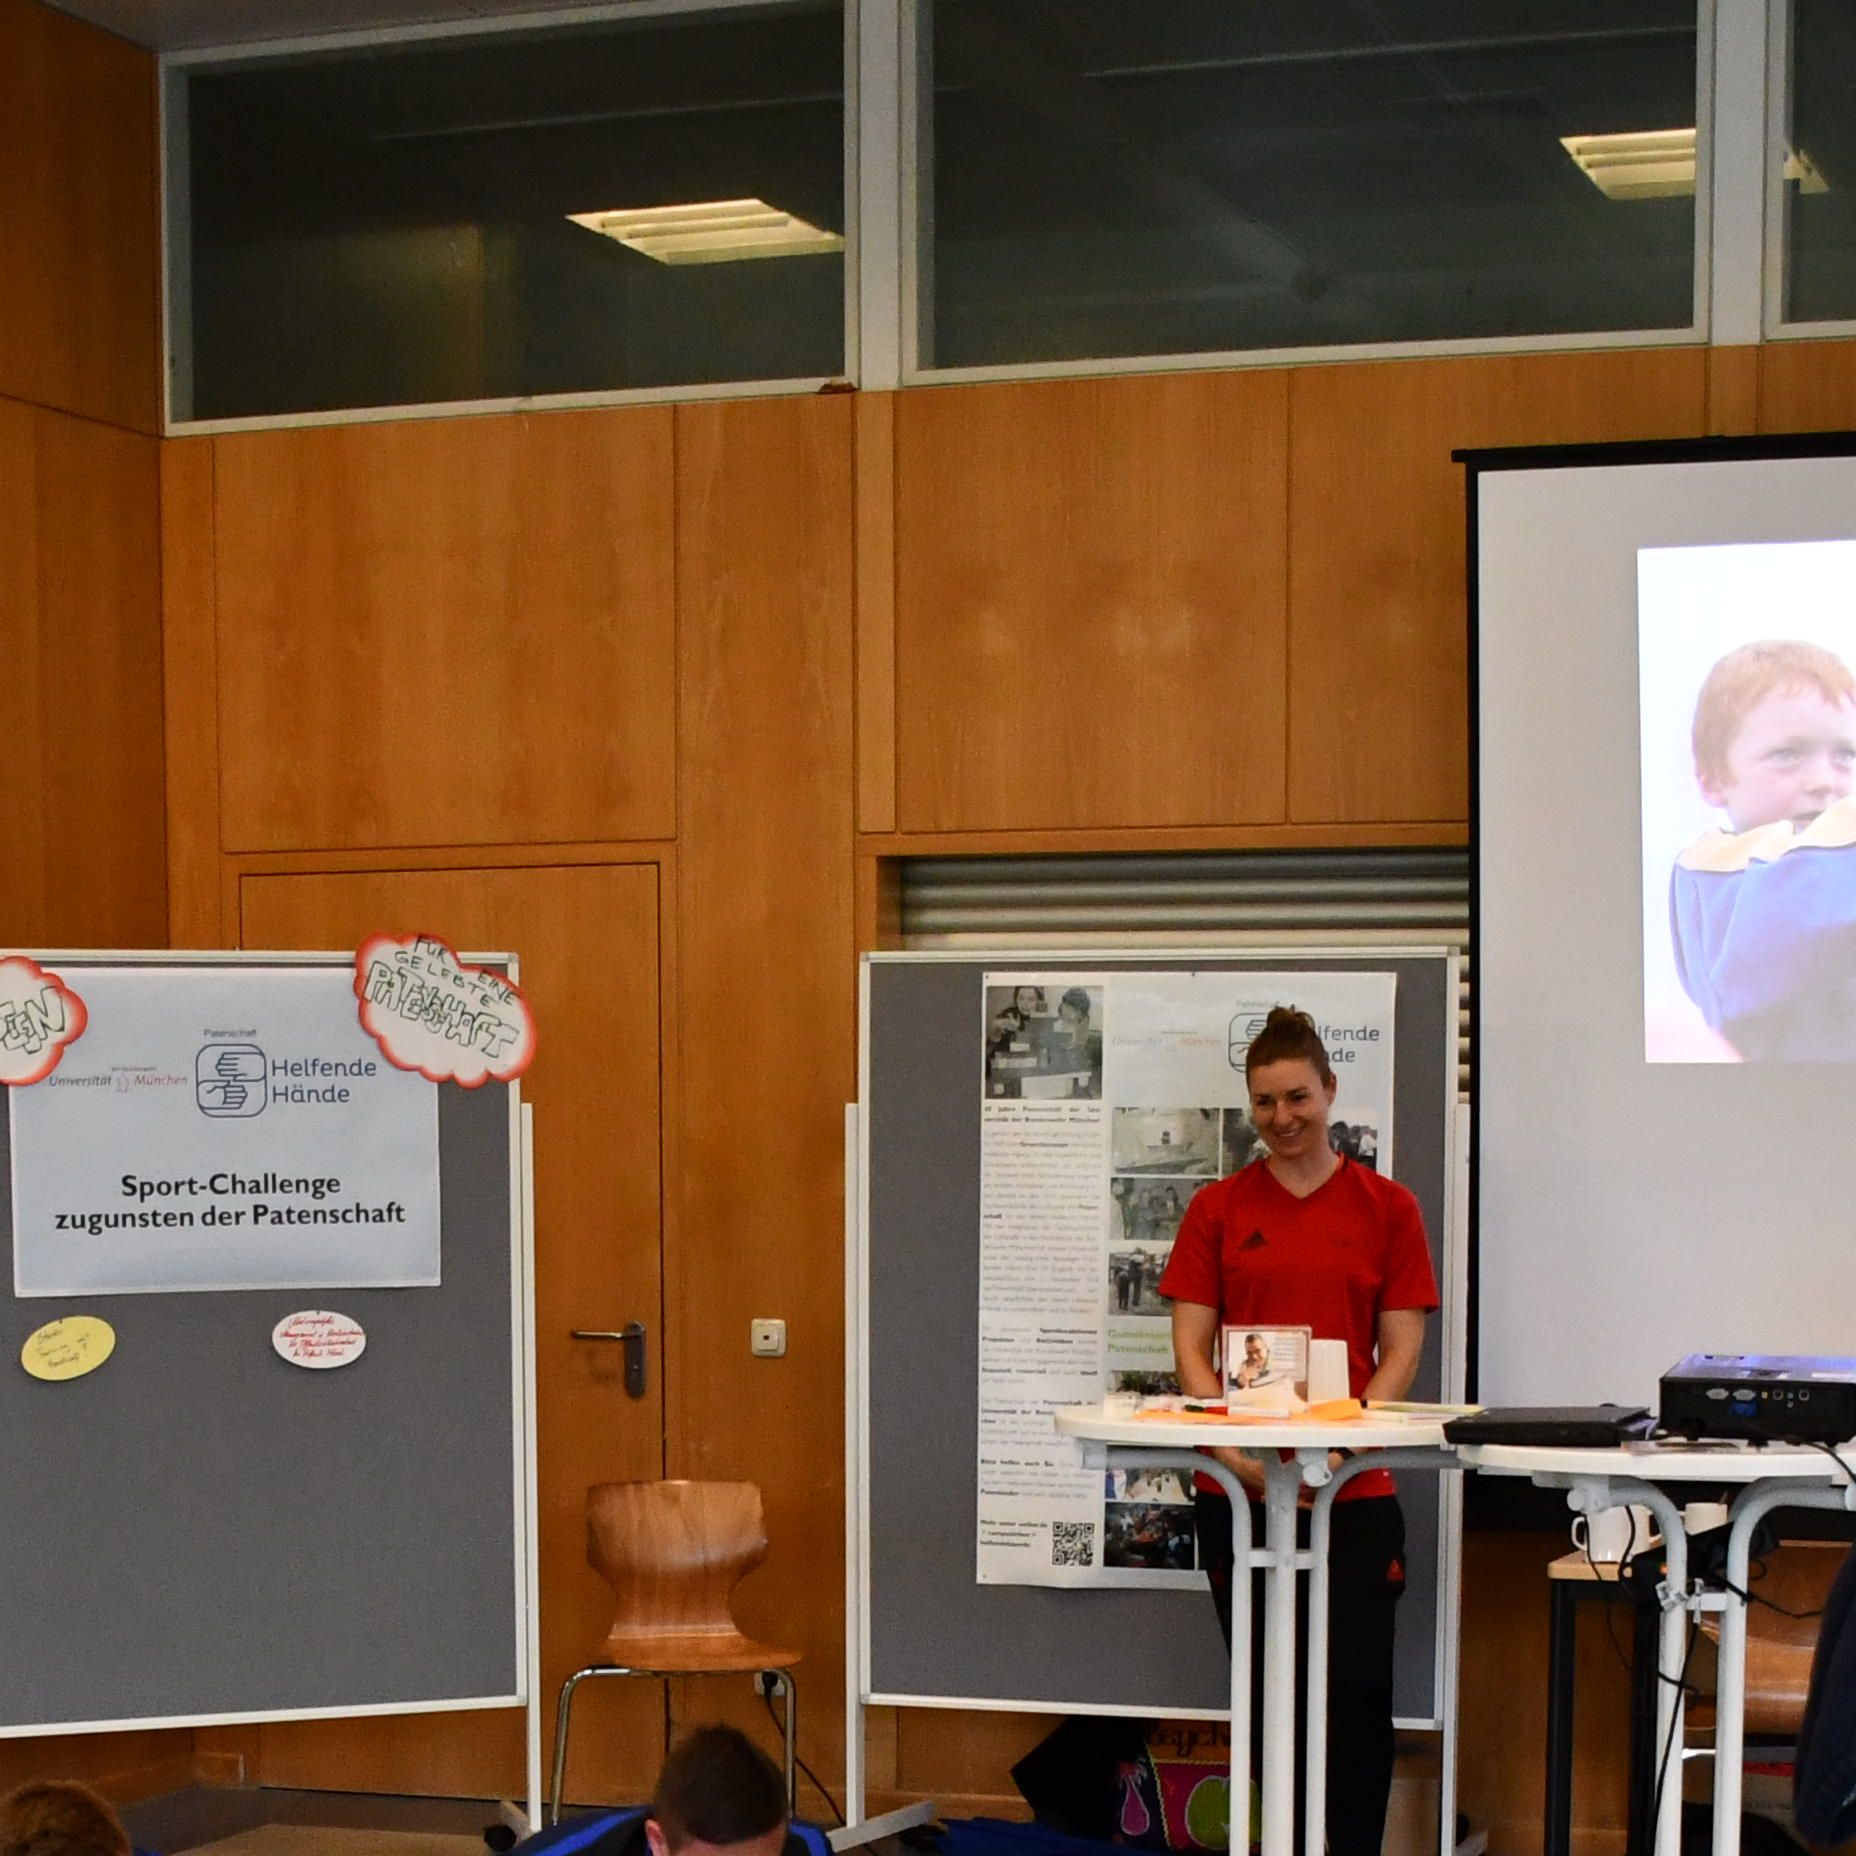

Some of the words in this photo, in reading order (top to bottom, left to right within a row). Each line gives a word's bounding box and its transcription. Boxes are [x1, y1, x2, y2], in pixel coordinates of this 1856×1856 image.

[394, 949, 496, 1009] GELEBTE
[414, 934, 448, 966] FÜR
[477, 969, 519, 1007] EINE
[1317, 1026, 1381, 1042] lfende
[272, 1058, 377, 1078] Helfende
[48, 1074, 112, 1087] Universität
[134, 1074, 189, 1086] München
[272, 1084, 351, 1104] Hände
[121, 1173, 342, 1202] Sport-Challenge
[55, 1207, 195, 1235] zugunsten
[201, 1205, 247, 1227] der
[252, 1201, 407, 1226] Patenschaft
